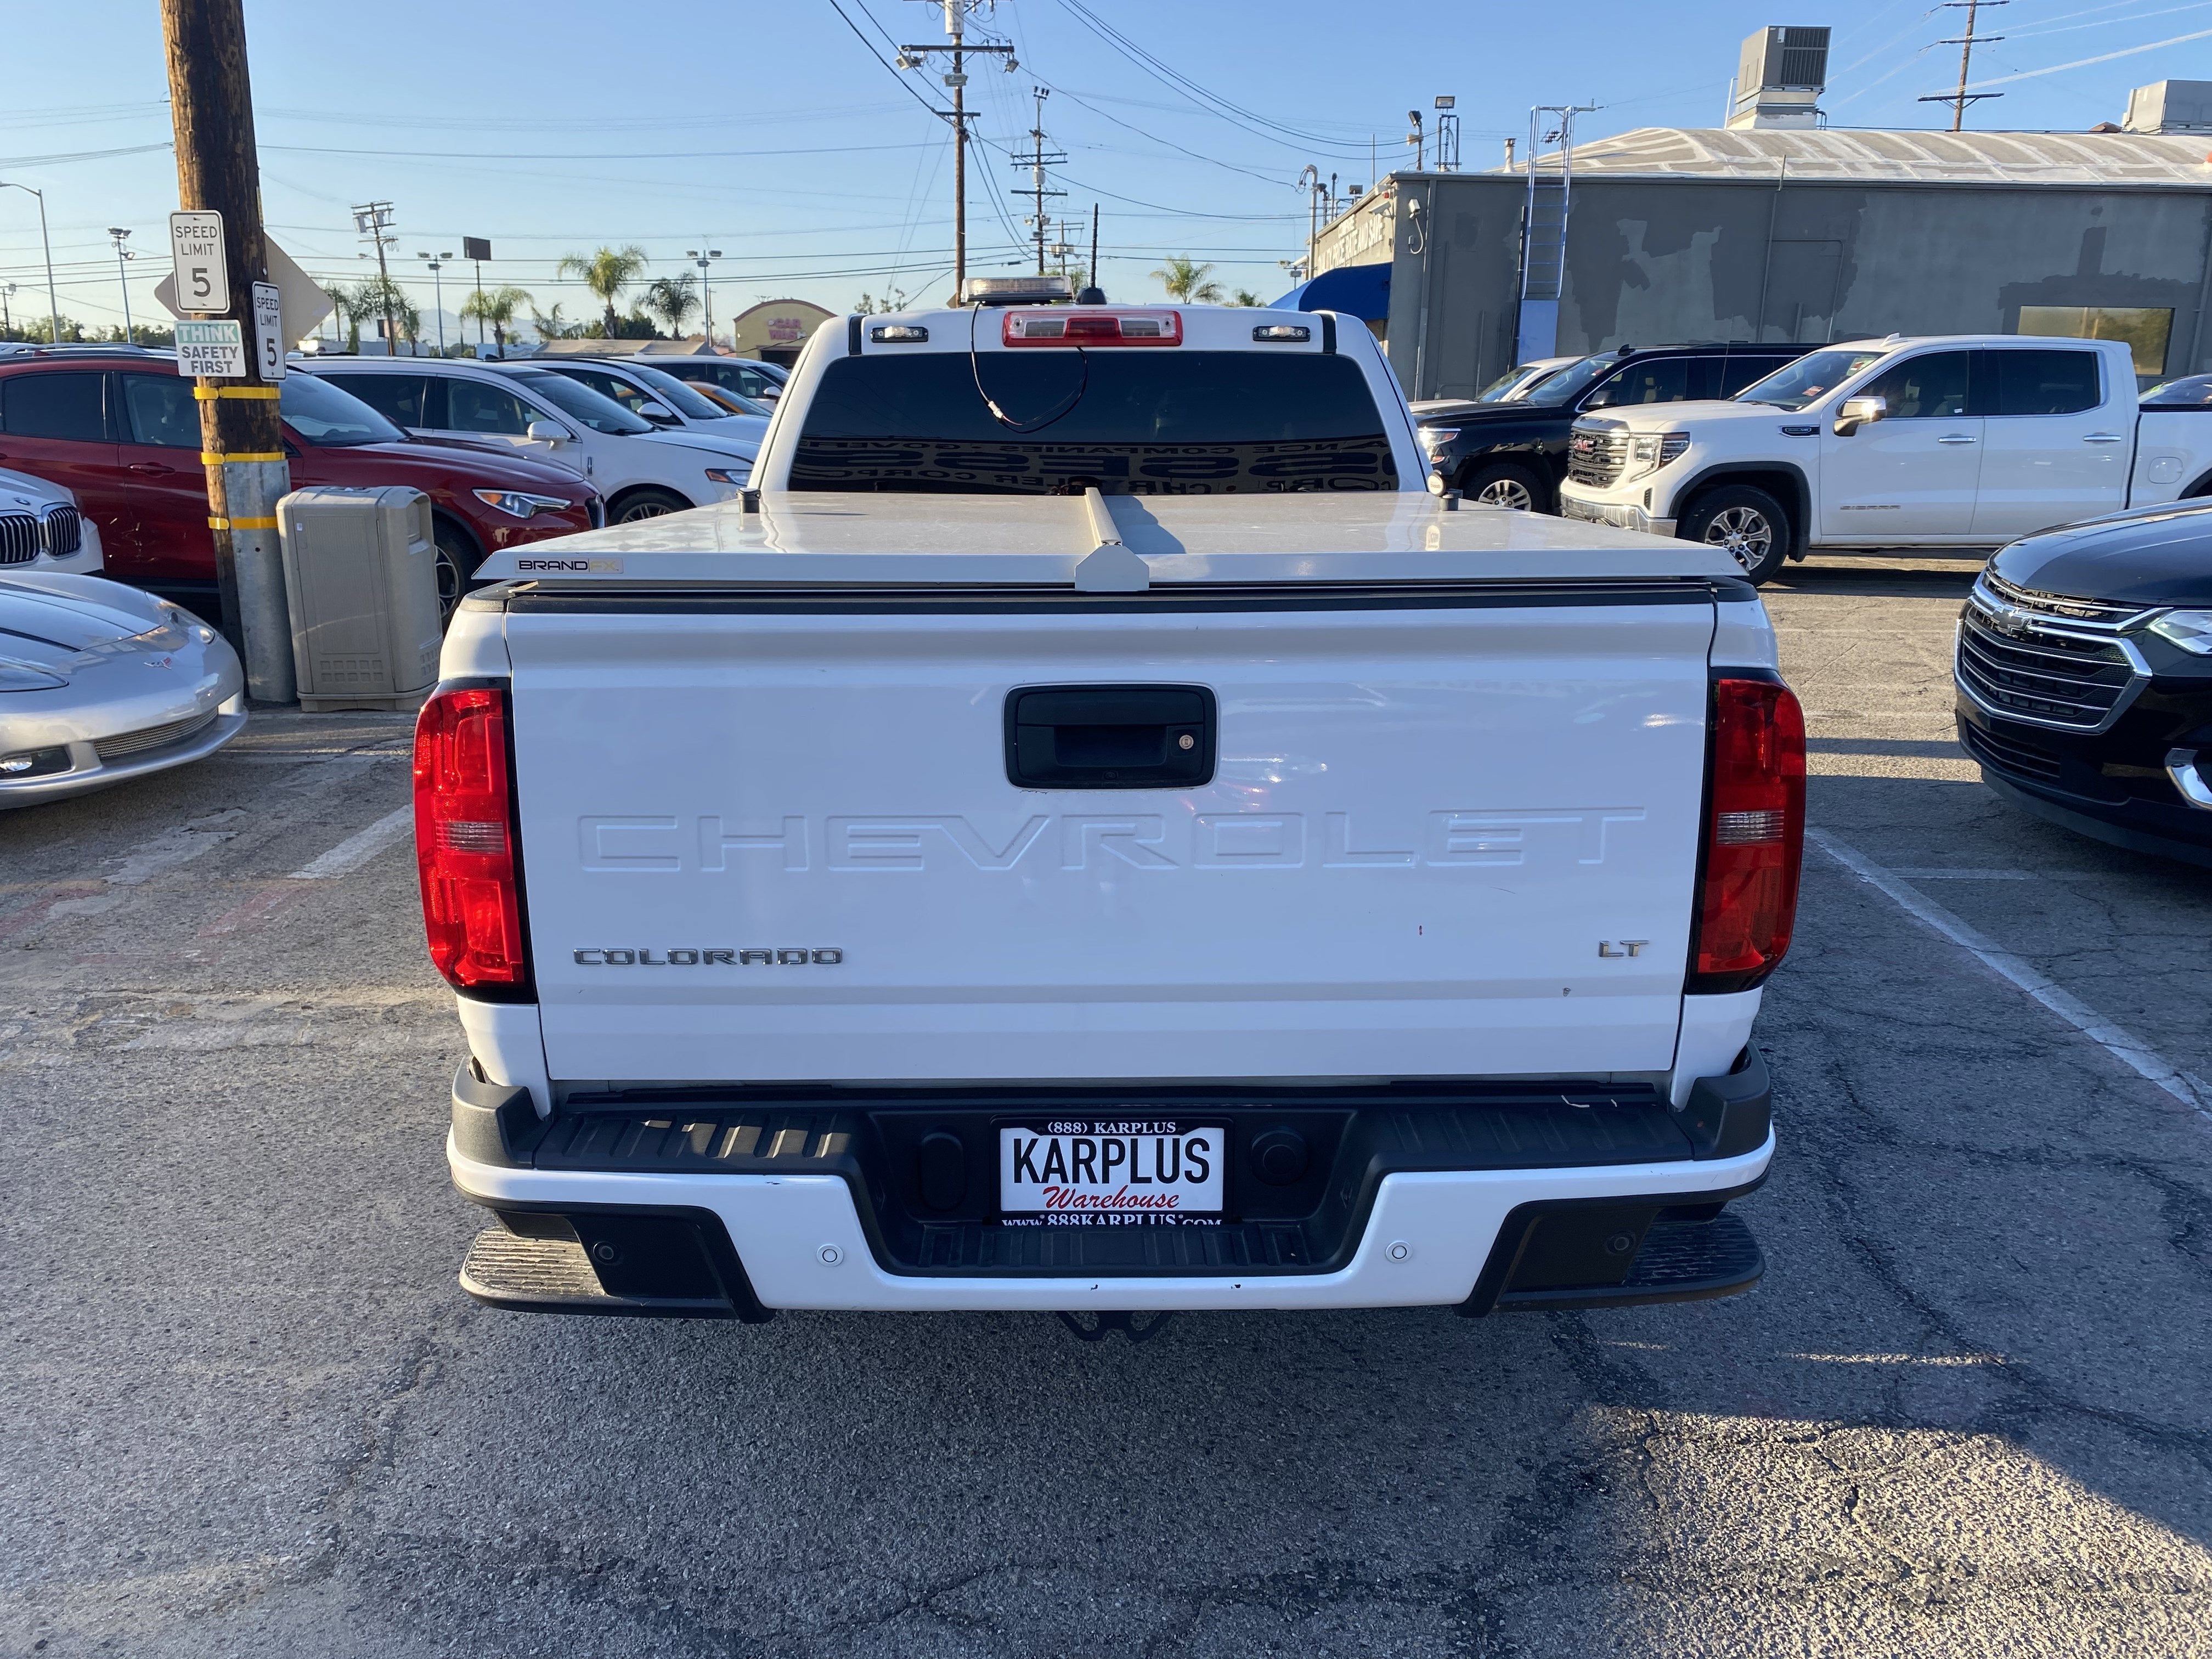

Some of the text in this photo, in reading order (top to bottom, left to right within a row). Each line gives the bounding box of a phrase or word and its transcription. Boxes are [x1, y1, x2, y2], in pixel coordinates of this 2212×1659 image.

[176, 226, 217, 238] SPEED
[180, 244, 214, 256] LIMIT
[192, 268, 211, 297] 5
[256, 297, 279, 311] SPEED
[260, 315, 277, 328] LIMIT
[774, 318, 802, 329] CAR
[179, 325, 237, 342] THINK
[182, 346, 238, 358] SAFETY
[267, 338, 277, 366] 5
[191, 361, 232, 373] FIRST
[578, 807, 1646, 871] CHEVROLET
[573, 947, 843, 965] COLORADO
[1599, 940, 1649, 957] LT
[1048, 1122, 1176, 1134] (888) KARPLUS
[1013, 1137, 1210, 1184] KARPLUS
[1042, 1185, 1180, 1209] Warehouse
